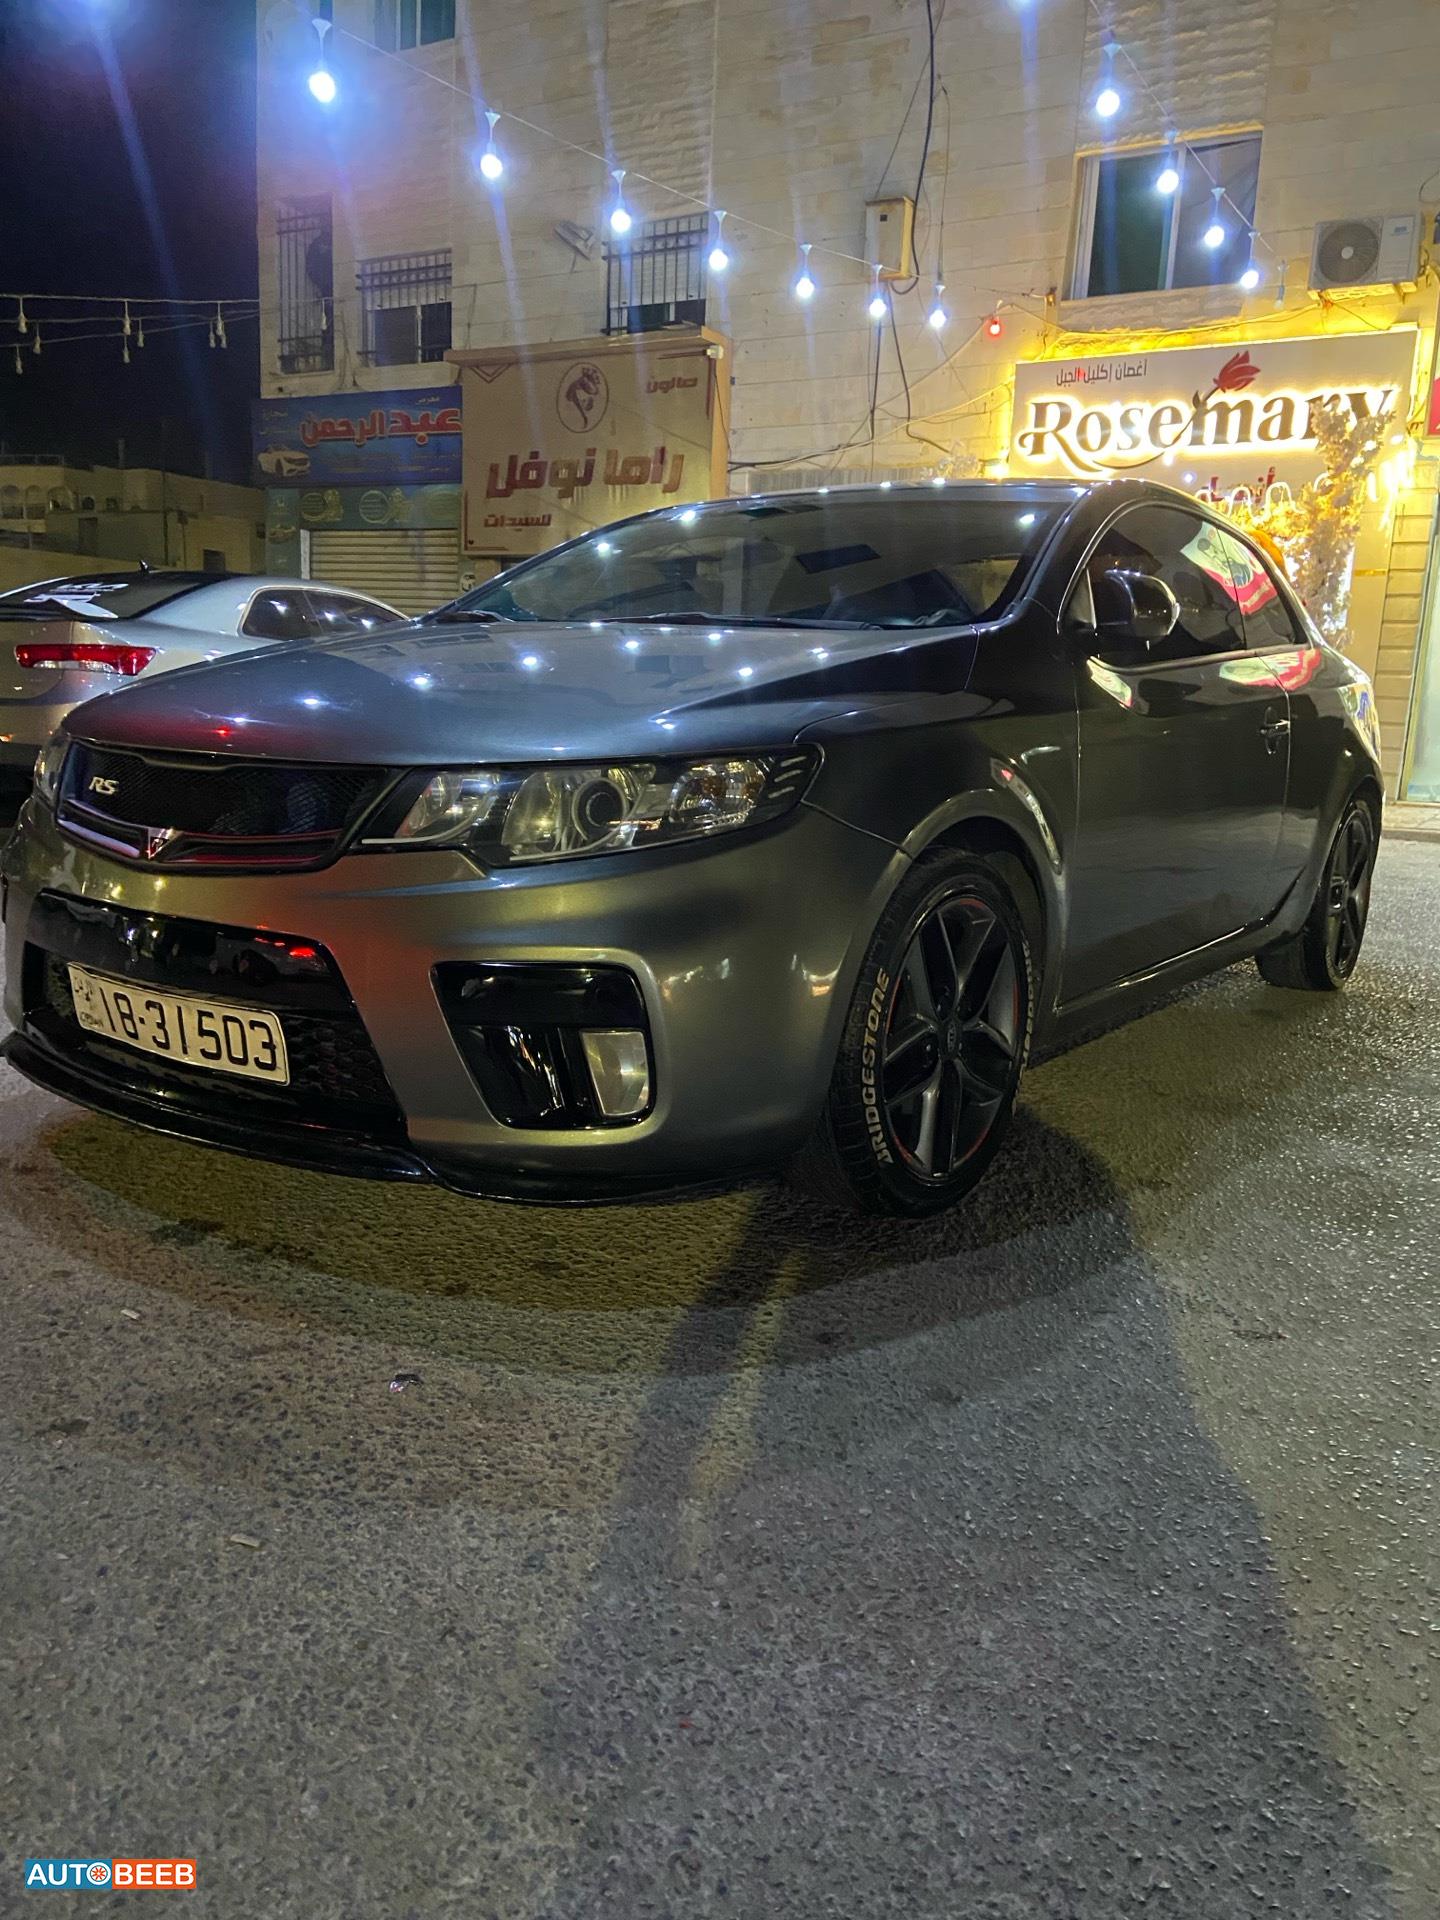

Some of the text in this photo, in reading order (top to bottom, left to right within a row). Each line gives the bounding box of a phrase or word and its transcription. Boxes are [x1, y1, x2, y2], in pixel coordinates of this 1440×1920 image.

[646, 375, 698, 394] صالون
[301, 408, 464, 448] عبد الرحمن
[1017, 388, 1393, 472] Rosemary
[486, 446, 685, 499] راما نوفل
[484, 513, 552, 532] للسيدات
[88, 776, 120, 795] RS
[99, 986, 277, 1072] 18-31503
[861, 967, 895, 1164] BRIDGESTONE
